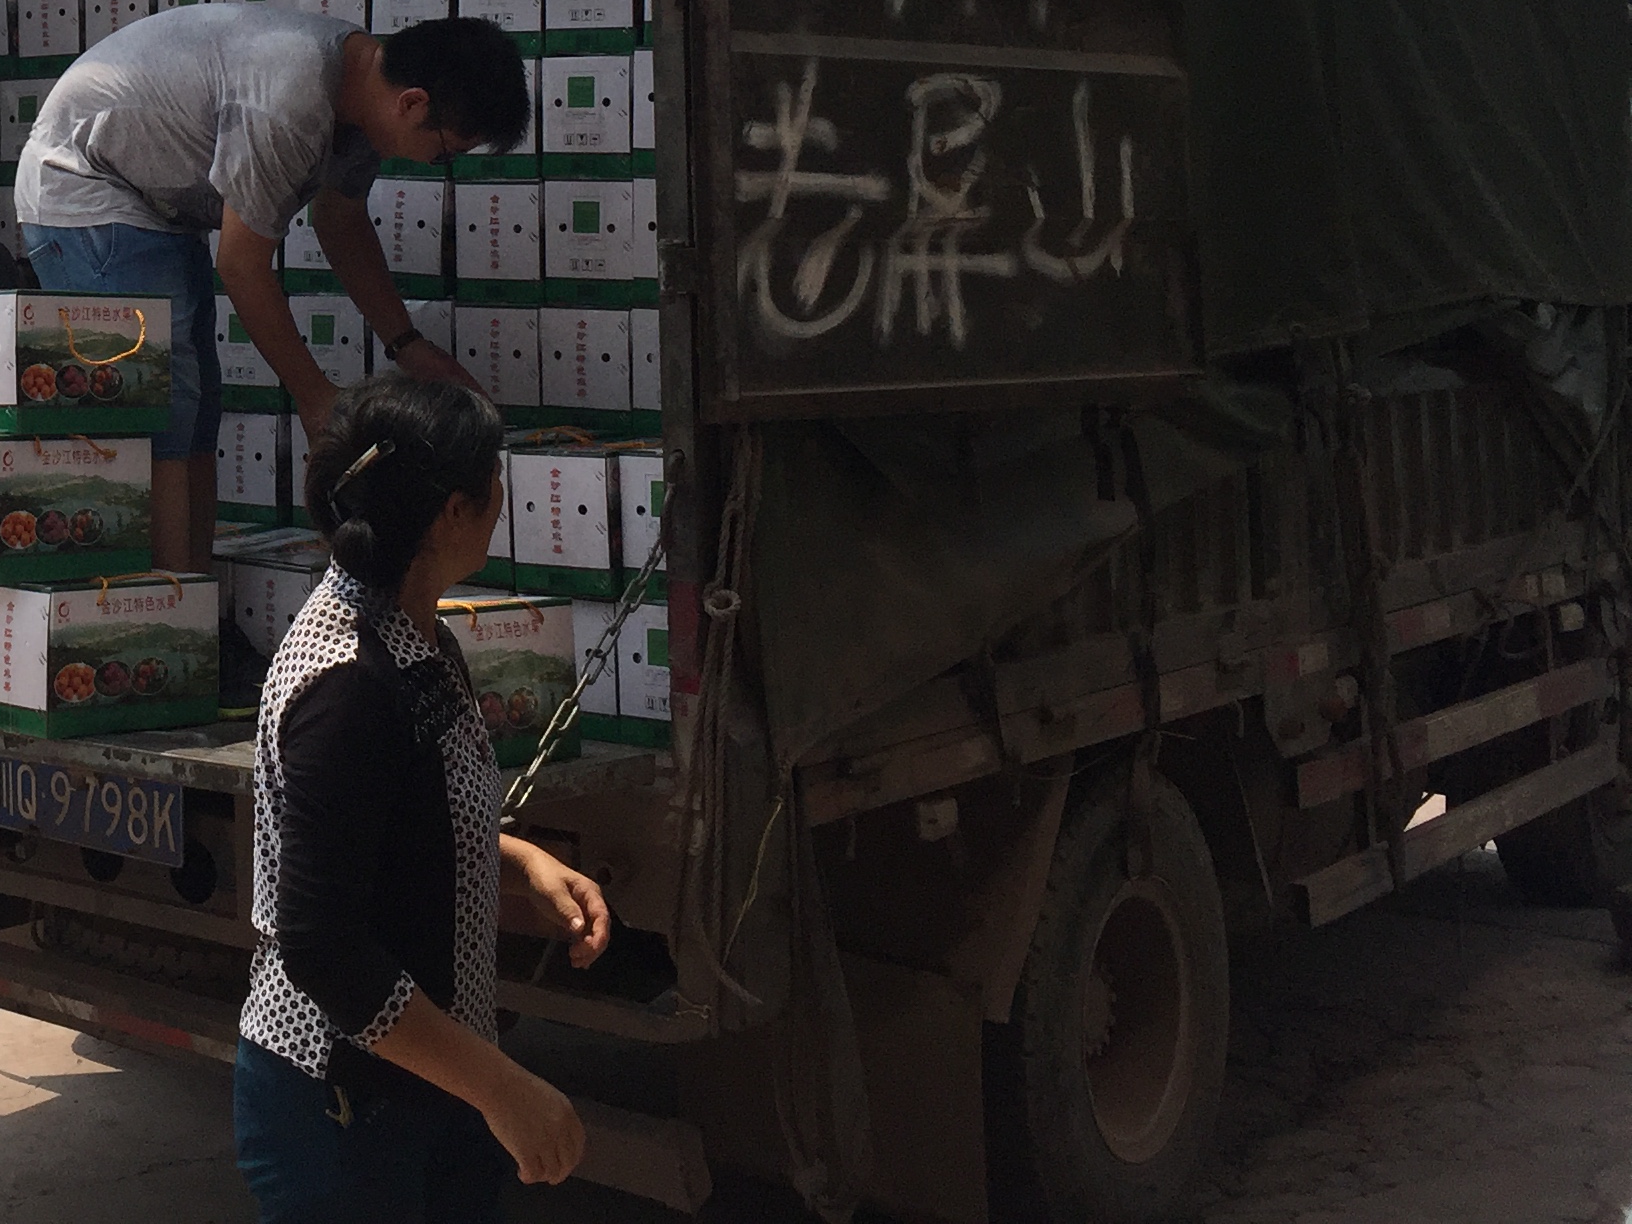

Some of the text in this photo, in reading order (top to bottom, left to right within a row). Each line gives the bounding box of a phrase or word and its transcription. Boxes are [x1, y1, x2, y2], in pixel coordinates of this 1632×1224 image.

[101, 593, 176, 616] 金沙江特色水果
